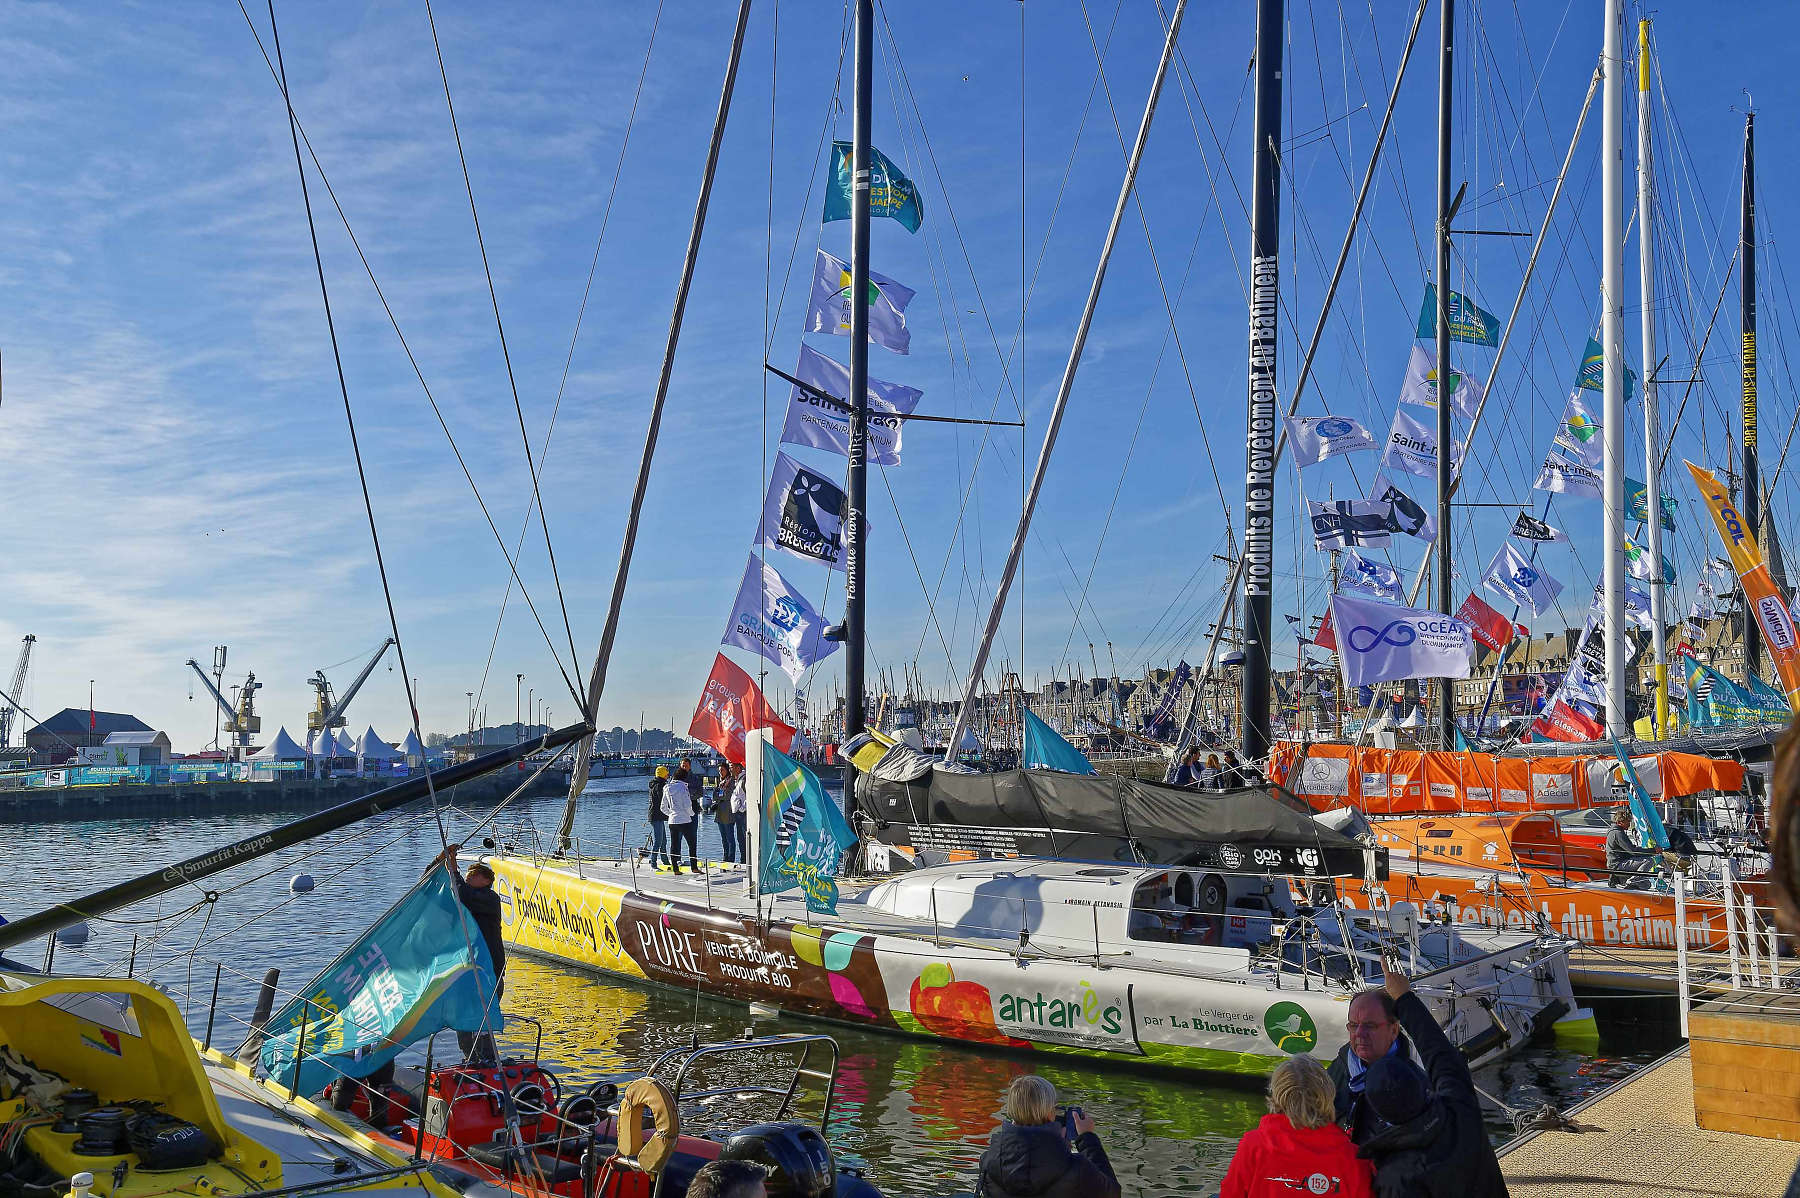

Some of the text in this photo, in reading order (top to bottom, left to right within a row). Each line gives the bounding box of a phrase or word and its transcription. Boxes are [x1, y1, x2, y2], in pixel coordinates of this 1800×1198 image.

[1250, 255, 1277, 340] Bâtiment
[1250, 345, 1275, 367] du
[1246, 371, 1274, 484] Revêtement
[1246, 488, 1272, 512] de
[1313, 516, 1341, 531] CNH
[1244, 516, 1272, 596] Produits
[184, 835, 273, 875] Smurfit Kappa
[514, 886, 559, 928] Famille
[556, 899, 598, 953] Mary
[1561, 902, 1596, 945] du
[636, 914, 707, 976] PURE
[704, 940, 737, 959] VENTE
[748, 950, 799, 970] DOMICILE
[719, 962, 771, 985] PRODUITS
[772, 973, 793, 989] BIO
[1143, 1015, 1164, 1026] par
[1169, 1015, 1190, 1029] La
[1199, 1008, 1255, 1022] Le Verger de
[1310, 1177, 1328, 1190] 152
